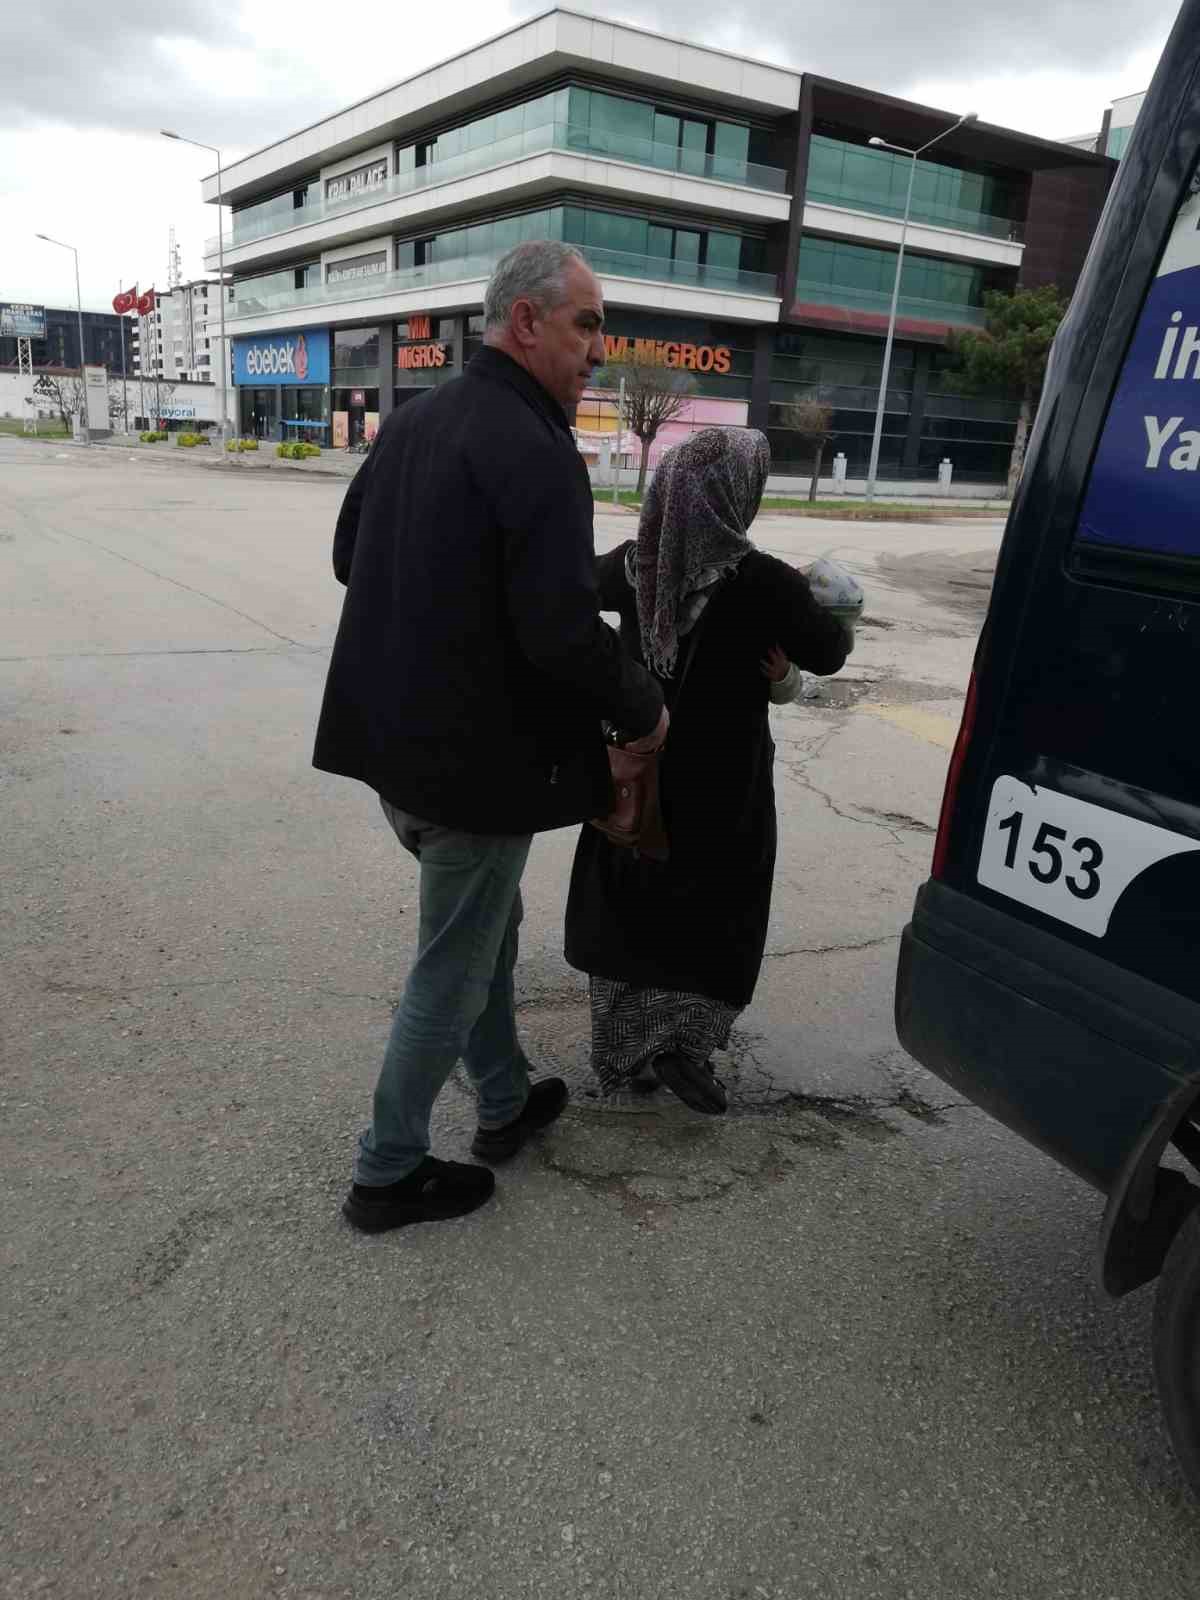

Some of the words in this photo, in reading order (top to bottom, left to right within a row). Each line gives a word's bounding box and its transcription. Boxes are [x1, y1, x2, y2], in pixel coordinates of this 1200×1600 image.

[246, 341, 296, 375] ebebek
[1144, 416, 1200, 471] Ya
[999, 811, 1104, 900] 153
